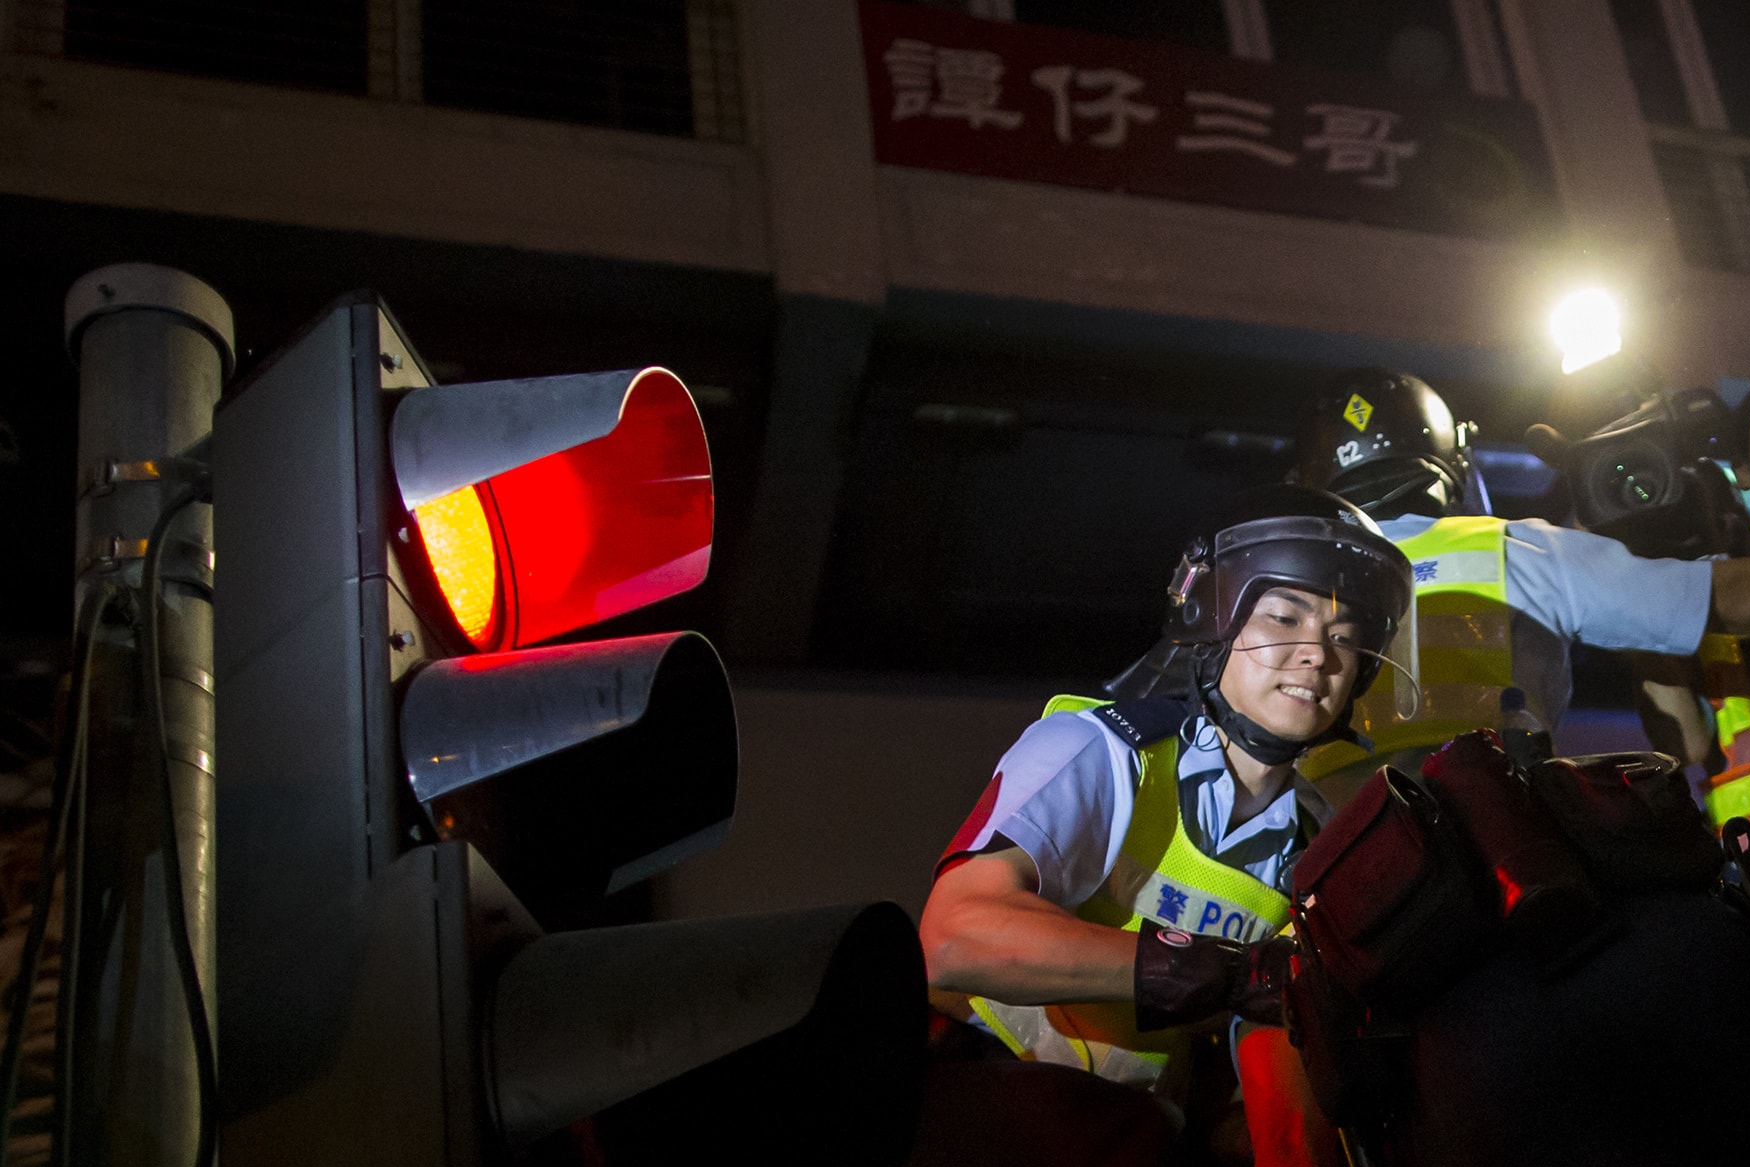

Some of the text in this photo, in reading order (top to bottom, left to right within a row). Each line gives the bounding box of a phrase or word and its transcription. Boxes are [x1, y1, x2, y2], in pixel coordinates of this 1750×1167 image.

[882, 37, 1418, 187] 譚仔三哥
[1156, 883, 1189, 925] 警
